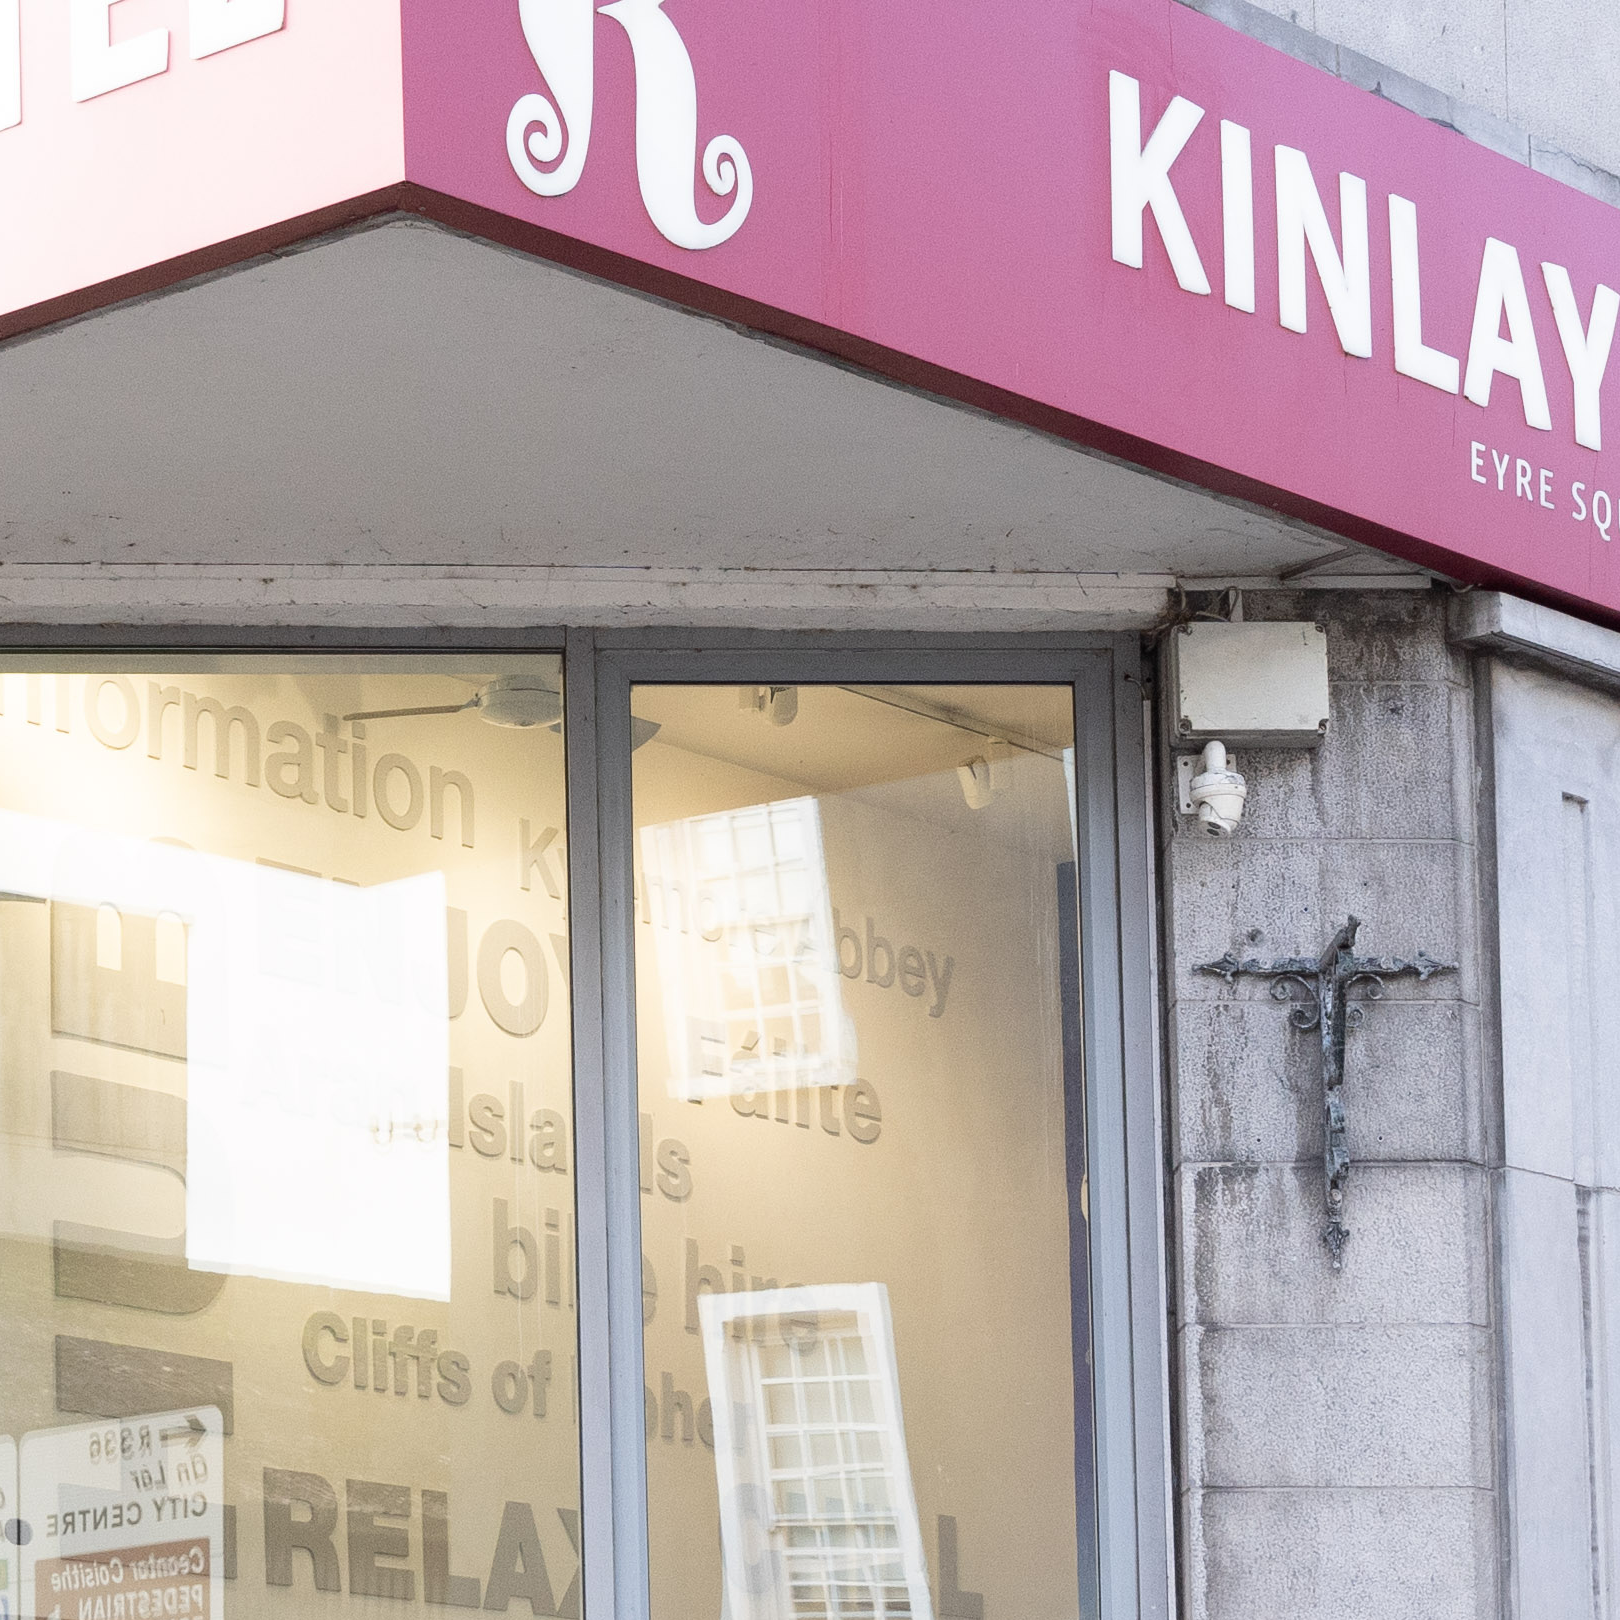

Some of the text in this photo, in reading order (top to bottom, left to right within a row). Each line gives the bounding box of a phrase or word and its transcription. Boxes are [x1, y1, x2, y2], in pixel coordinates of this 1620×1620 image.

[1108, 69, 1620, 451] KINLAY
[1469, 439, 1557, 512] EYRE
[301, 1310, 472, 1407] Cliffs
[491, 1349, 553, 1417] of
